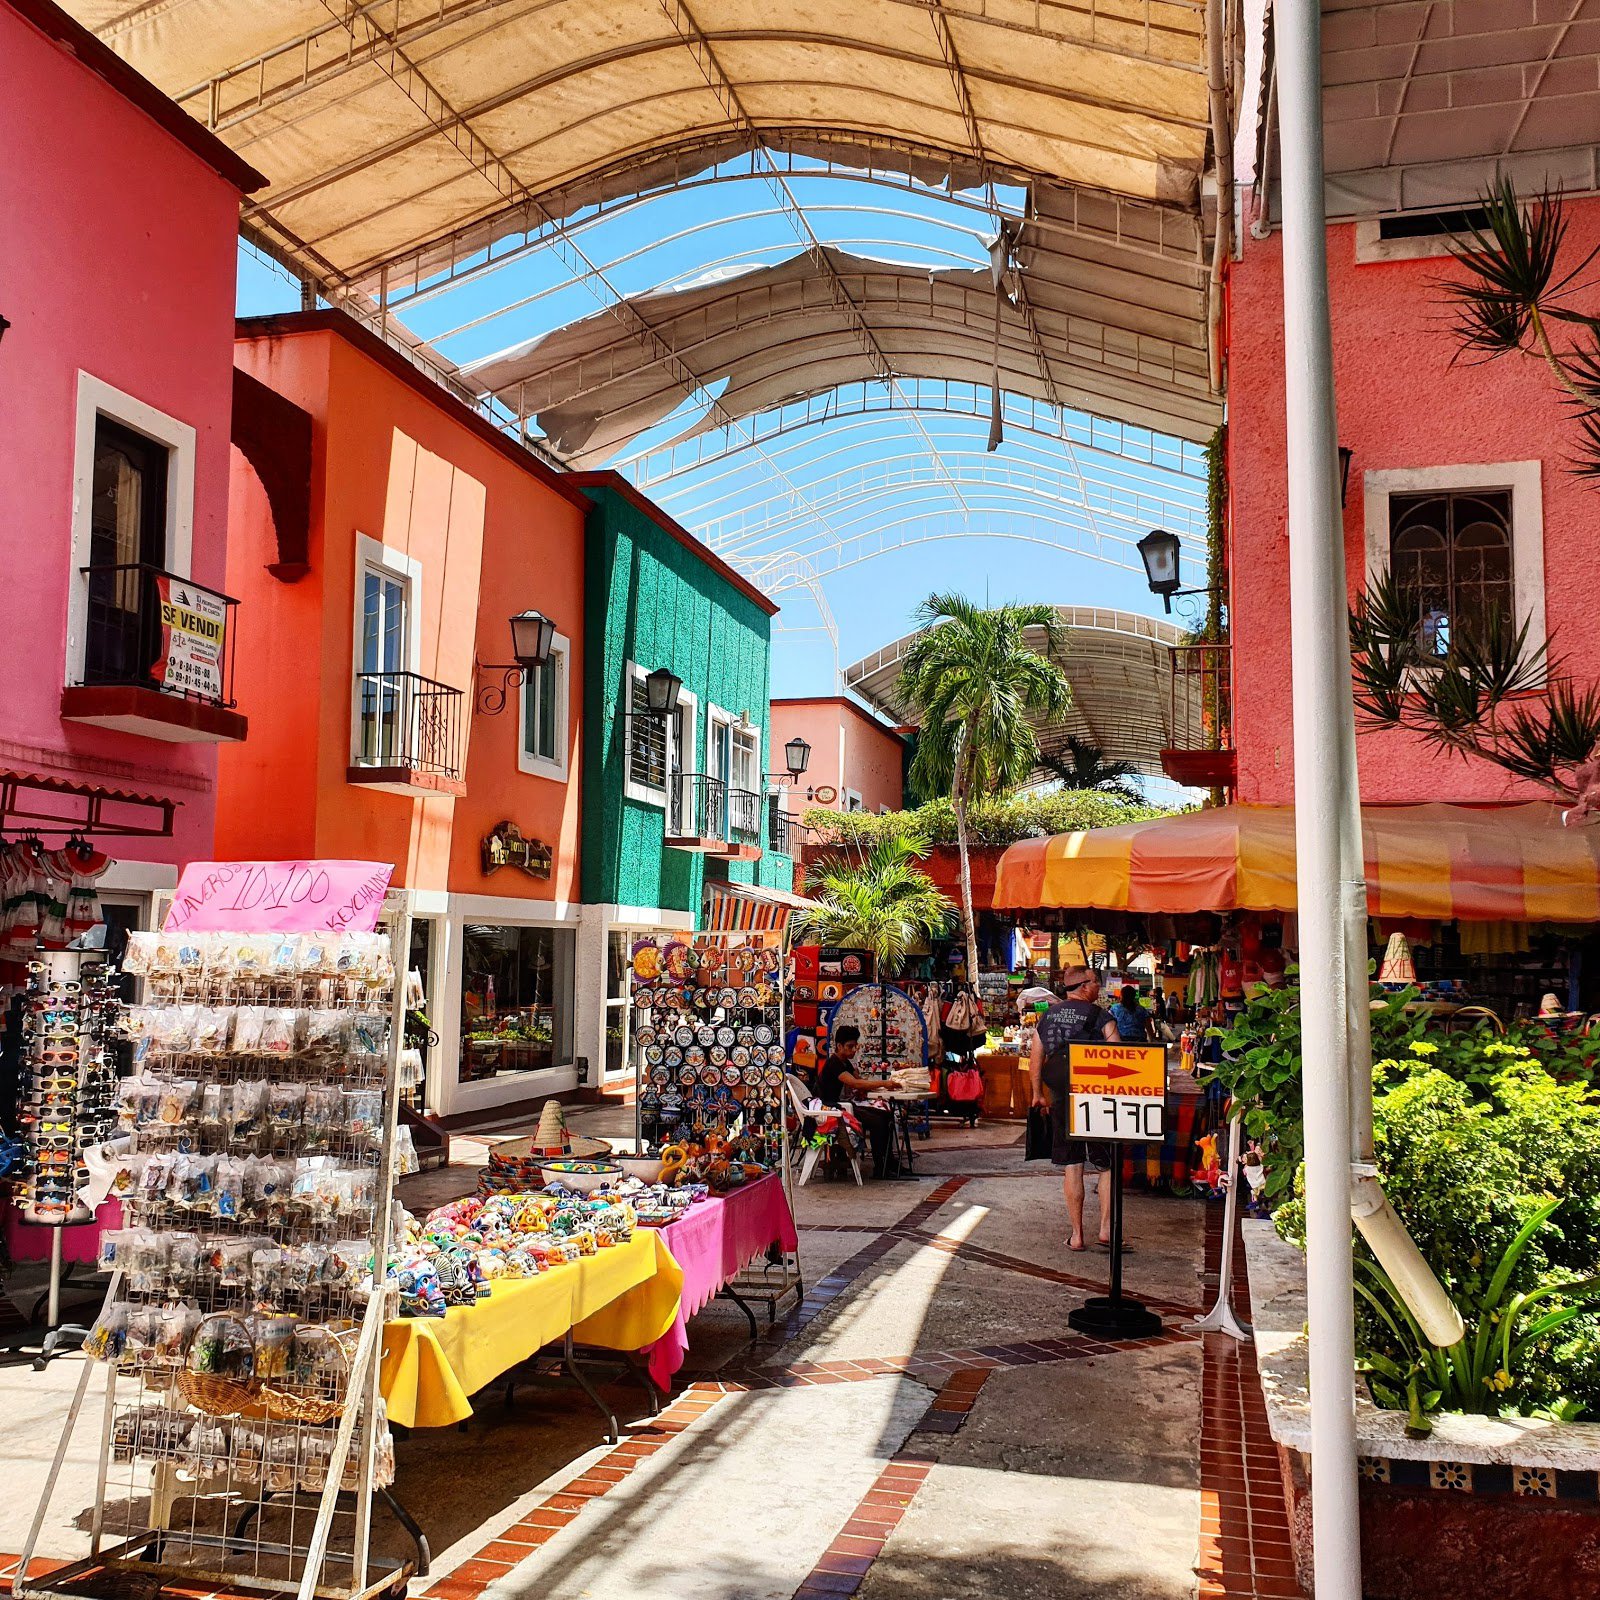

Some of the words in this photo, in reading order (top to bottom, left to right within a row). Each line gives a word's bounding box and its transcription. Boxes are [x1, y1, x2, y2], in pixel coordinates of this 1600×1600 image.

[163, 605, 177, 624] SE
[325, 867, 392, 930] KEYCHAINS
[1046, 1013, 1088, 1023] FRECRACKER
[1084, 1048, 1148, 1060] MONEY
[1071, 1084, 1164, 1097] EXCHANGE
